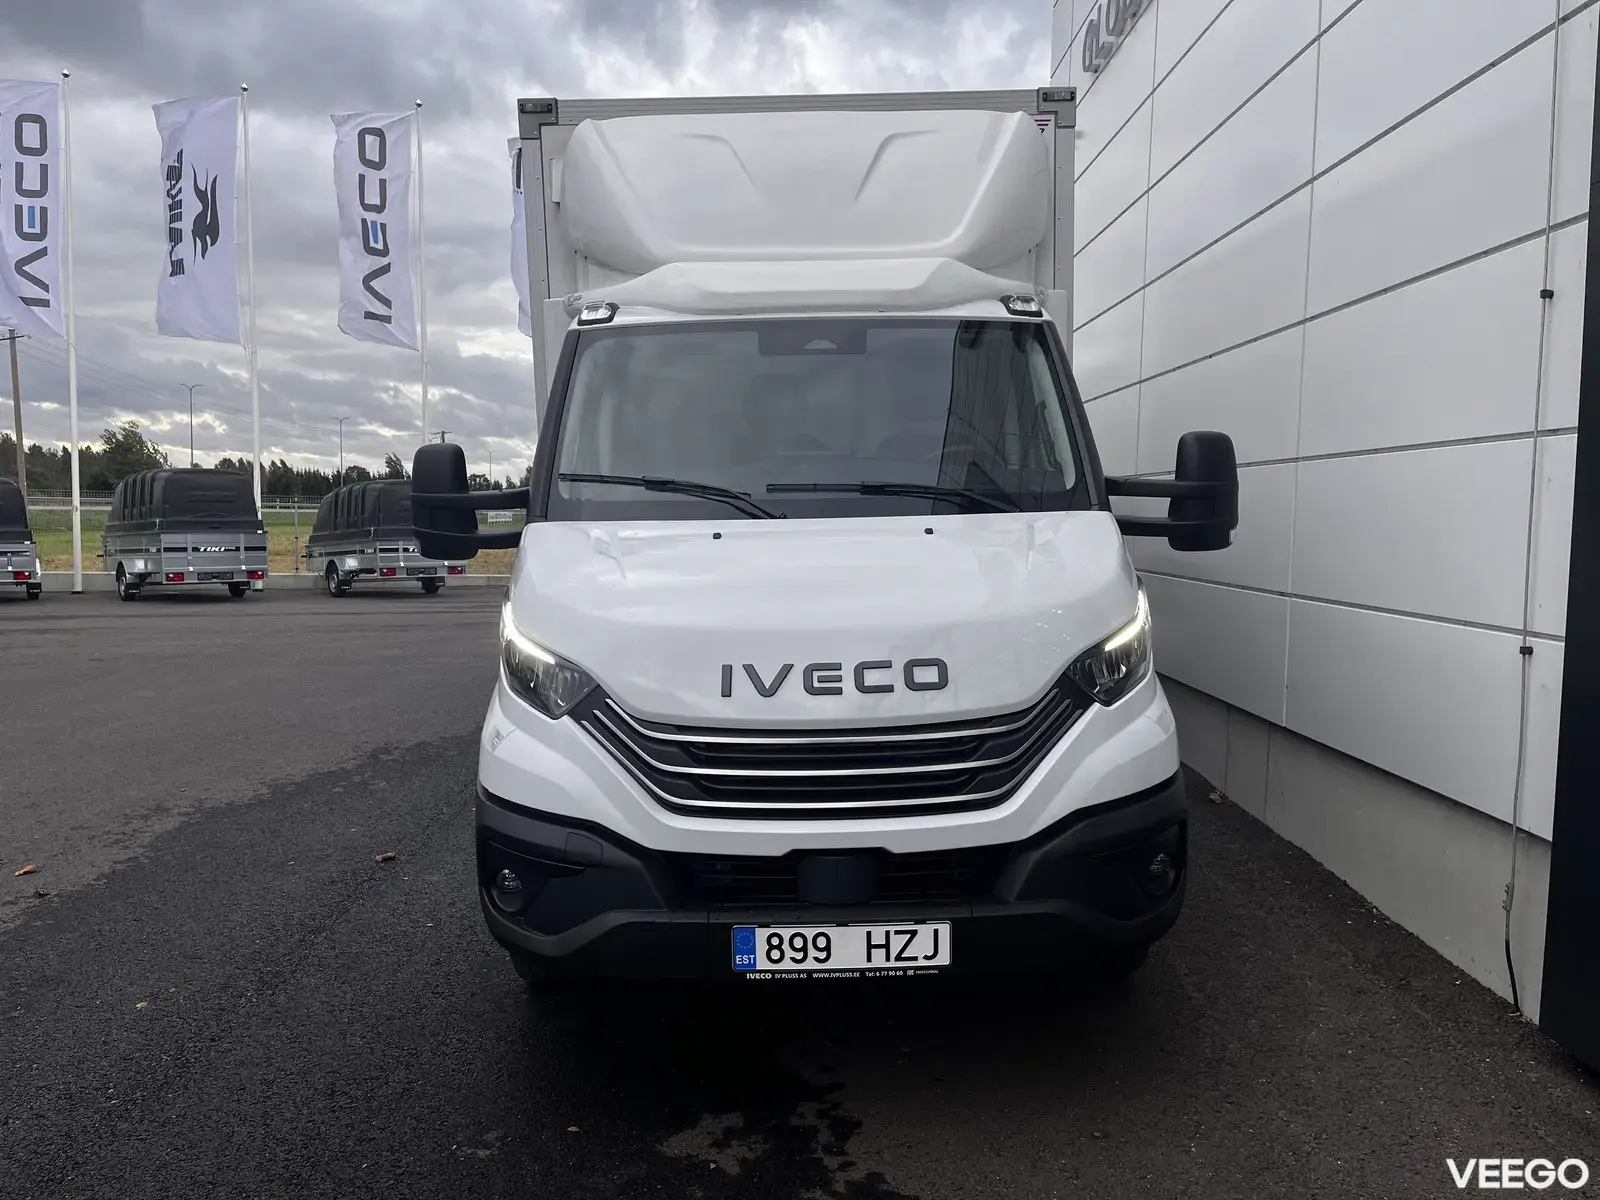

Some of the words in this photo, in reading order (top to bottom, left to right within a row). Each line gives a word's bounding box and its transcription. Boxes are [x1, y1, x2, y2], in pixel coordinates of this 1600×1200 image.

[721, 657, 949, 698] IVECO
[735, 955, 755, 964] EST
[765, 931, 832, 965] 899
[865, 928, 939, 963] HZJ
